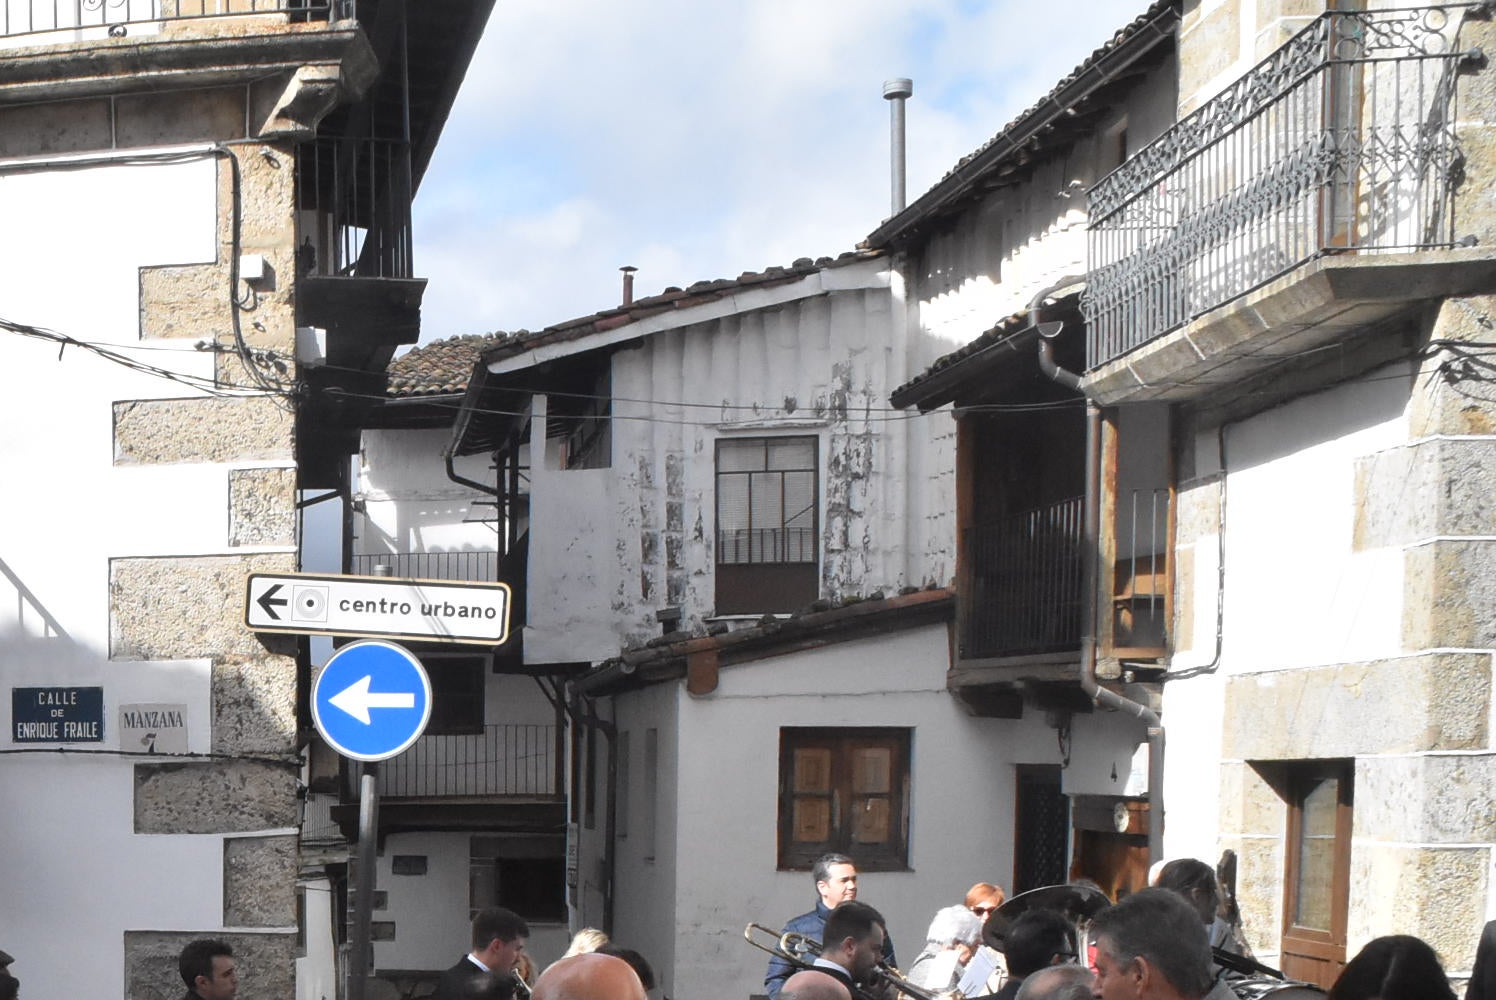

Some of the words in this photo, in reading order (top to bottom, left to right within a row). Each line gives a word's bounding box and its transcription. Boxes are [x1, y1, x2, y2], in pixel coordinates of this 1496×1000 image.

[339, 598, 412, 615] centro
[420, 601, 497, 620] urbano
[38, 691, 78, 705] CALLE
[50, 709, 65, 718] DE
[123, 711, 184, 729] MANZANA
[17, 721, 59, 739] ENRIQUE
[64, 721, 98, 739] FRAILE
